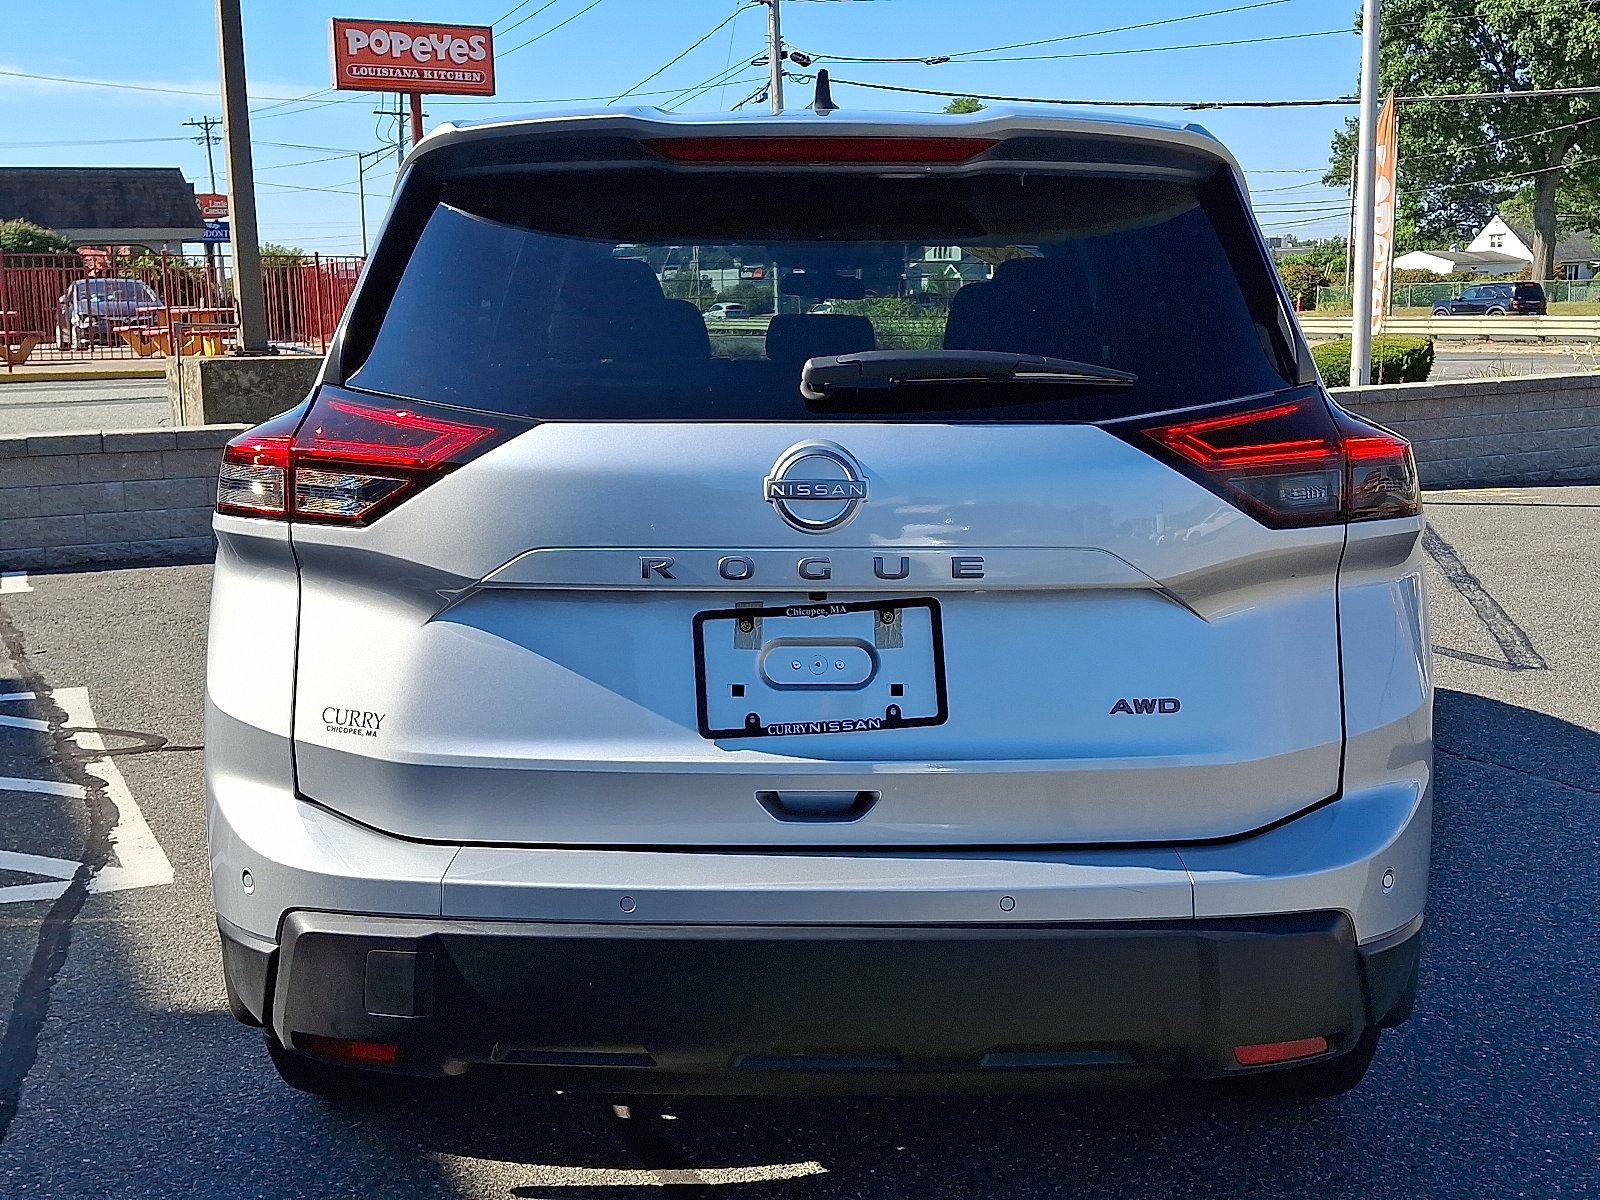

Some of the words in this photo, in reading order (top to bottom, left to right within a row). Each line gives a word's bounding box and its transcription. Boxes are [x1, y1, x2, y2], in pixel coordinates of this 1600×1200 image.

[351, 66, 420, 79] LOUISIANA
[423, 70, 482, 82] KITCHEN
[770, 484, 863, 496] NISSAN
[639, 555, 986, 580] ROGUE
[830, 605, 847, 615] MA
[1108, 698, 1181, 714] AWD
[322, 706, 386, 730] CURRY
[326, 725, 364, 737] CHICOPEE,
[366, 730, 378, 738] MA
